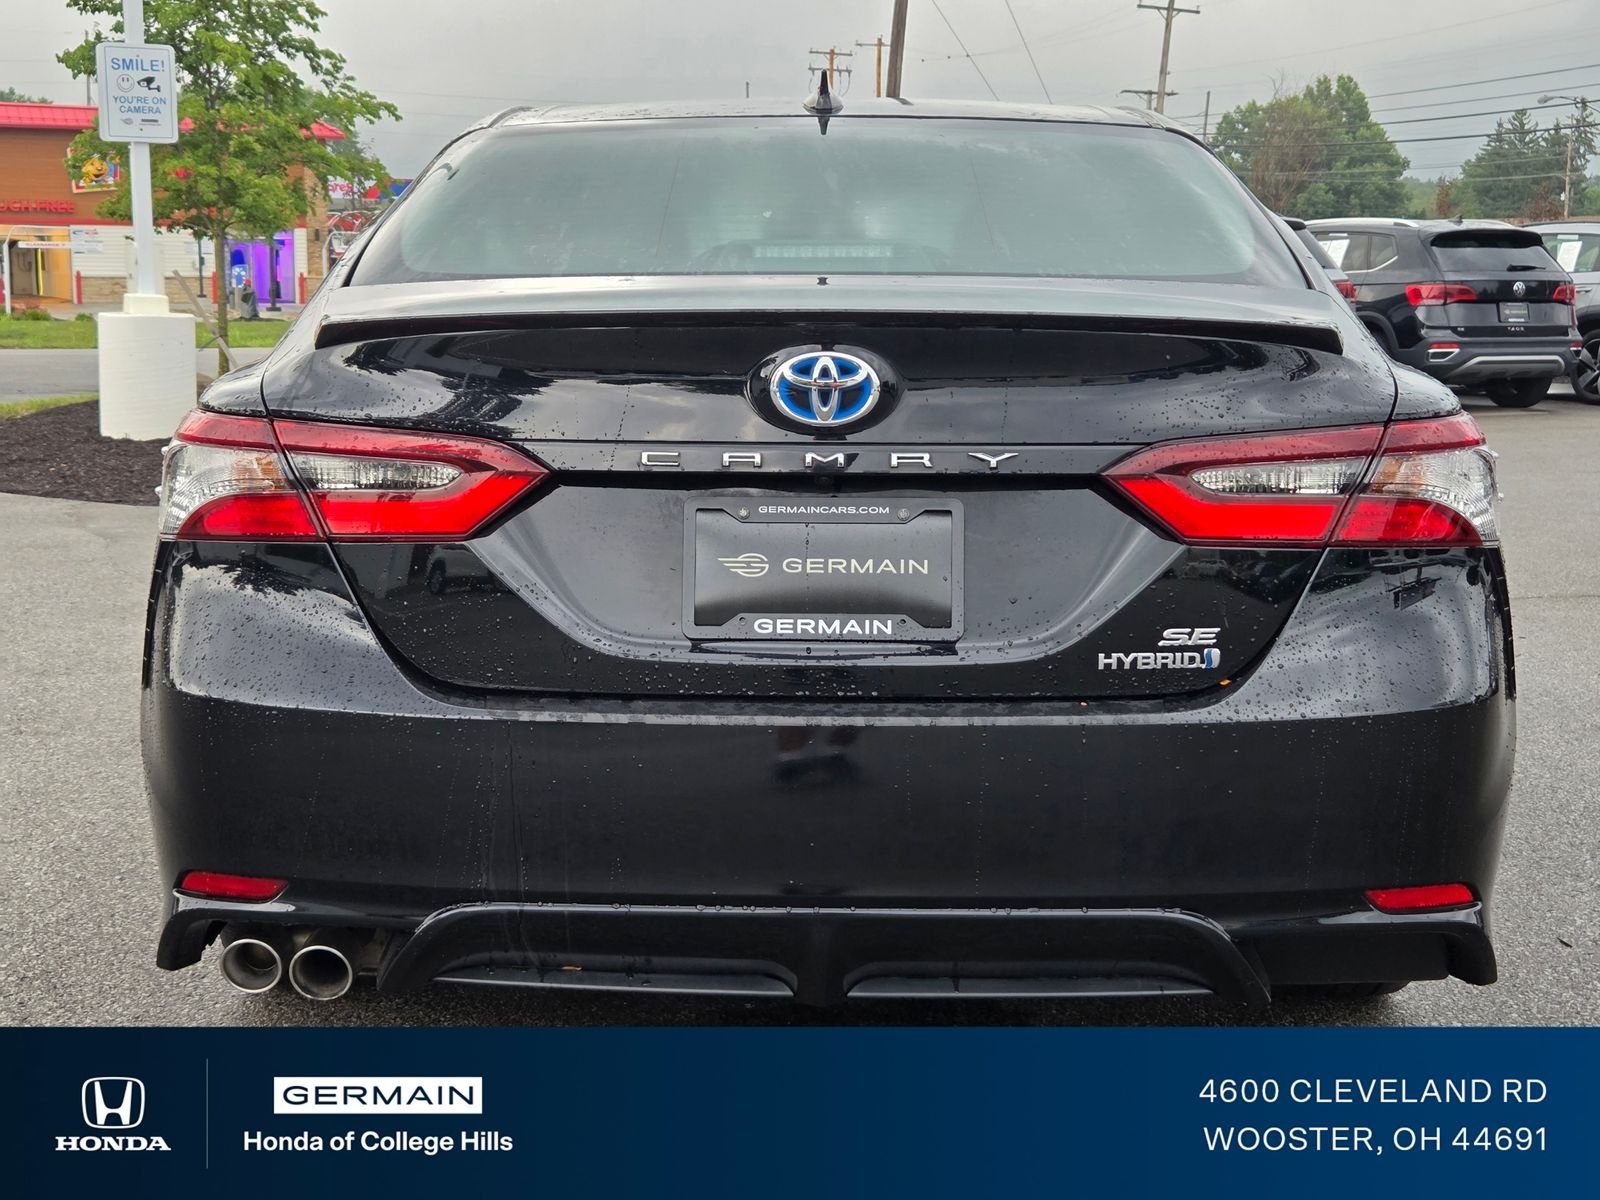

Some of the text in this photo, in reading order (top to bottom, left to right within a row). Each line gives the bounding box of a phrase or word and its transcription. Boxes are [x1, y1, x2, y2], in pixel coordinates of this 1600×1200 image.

[111, 57, 165, 72] SMILE!
[113, 96, 167, 105] YOU'RE ON
[119, 105, 162, 115] CAMERA
[640, 452, 1019, 468] CAMRY
[758, 505, 890, 515] GERMAINCARS.COM
[782, 558, 929, 575] GERMAIN
[753, 618, 893, 635] GERMAIN
[1158, 627, 1221, 646] SE
[1098, 652, 1202, 670] HYBRID
